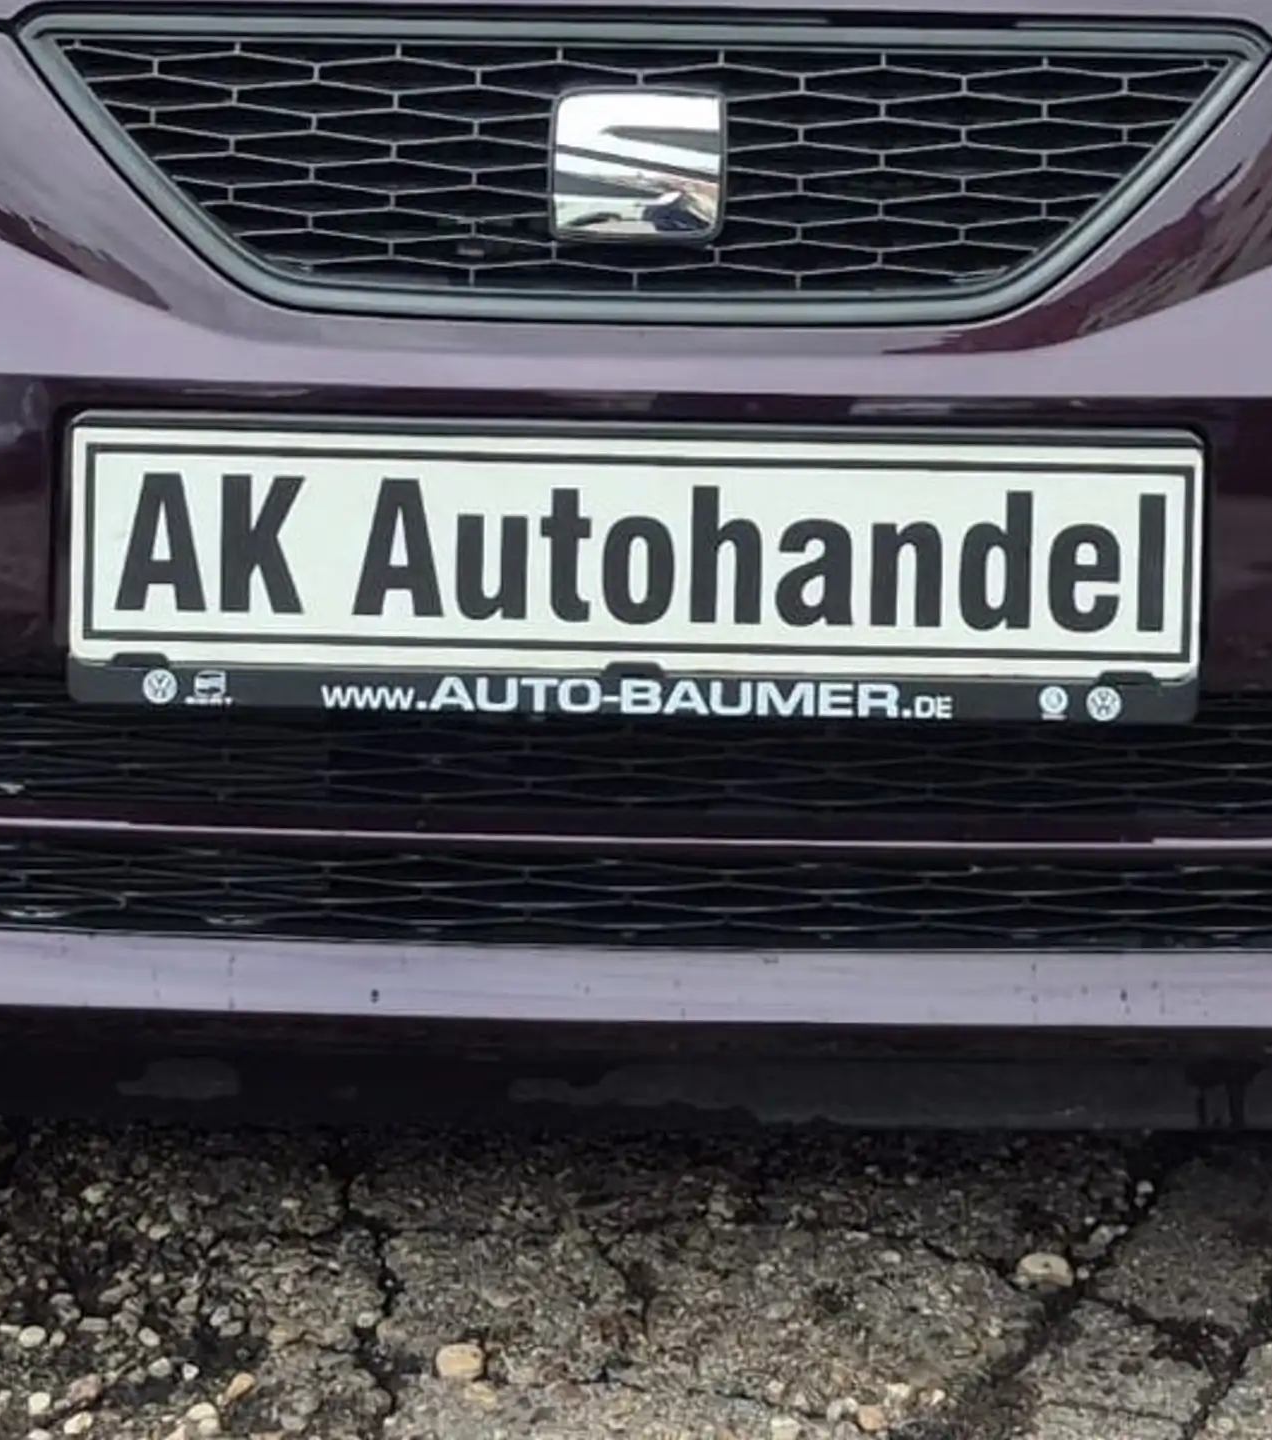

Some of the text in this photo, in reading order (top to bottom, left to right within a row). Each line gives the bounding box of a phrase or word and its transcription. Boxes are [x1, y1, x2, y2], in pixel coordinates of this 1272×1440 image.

[114, 473, 1166, 633] AK Autohandel
[321, 676, 953, 721] www.AUTO-BAUMER.DE
